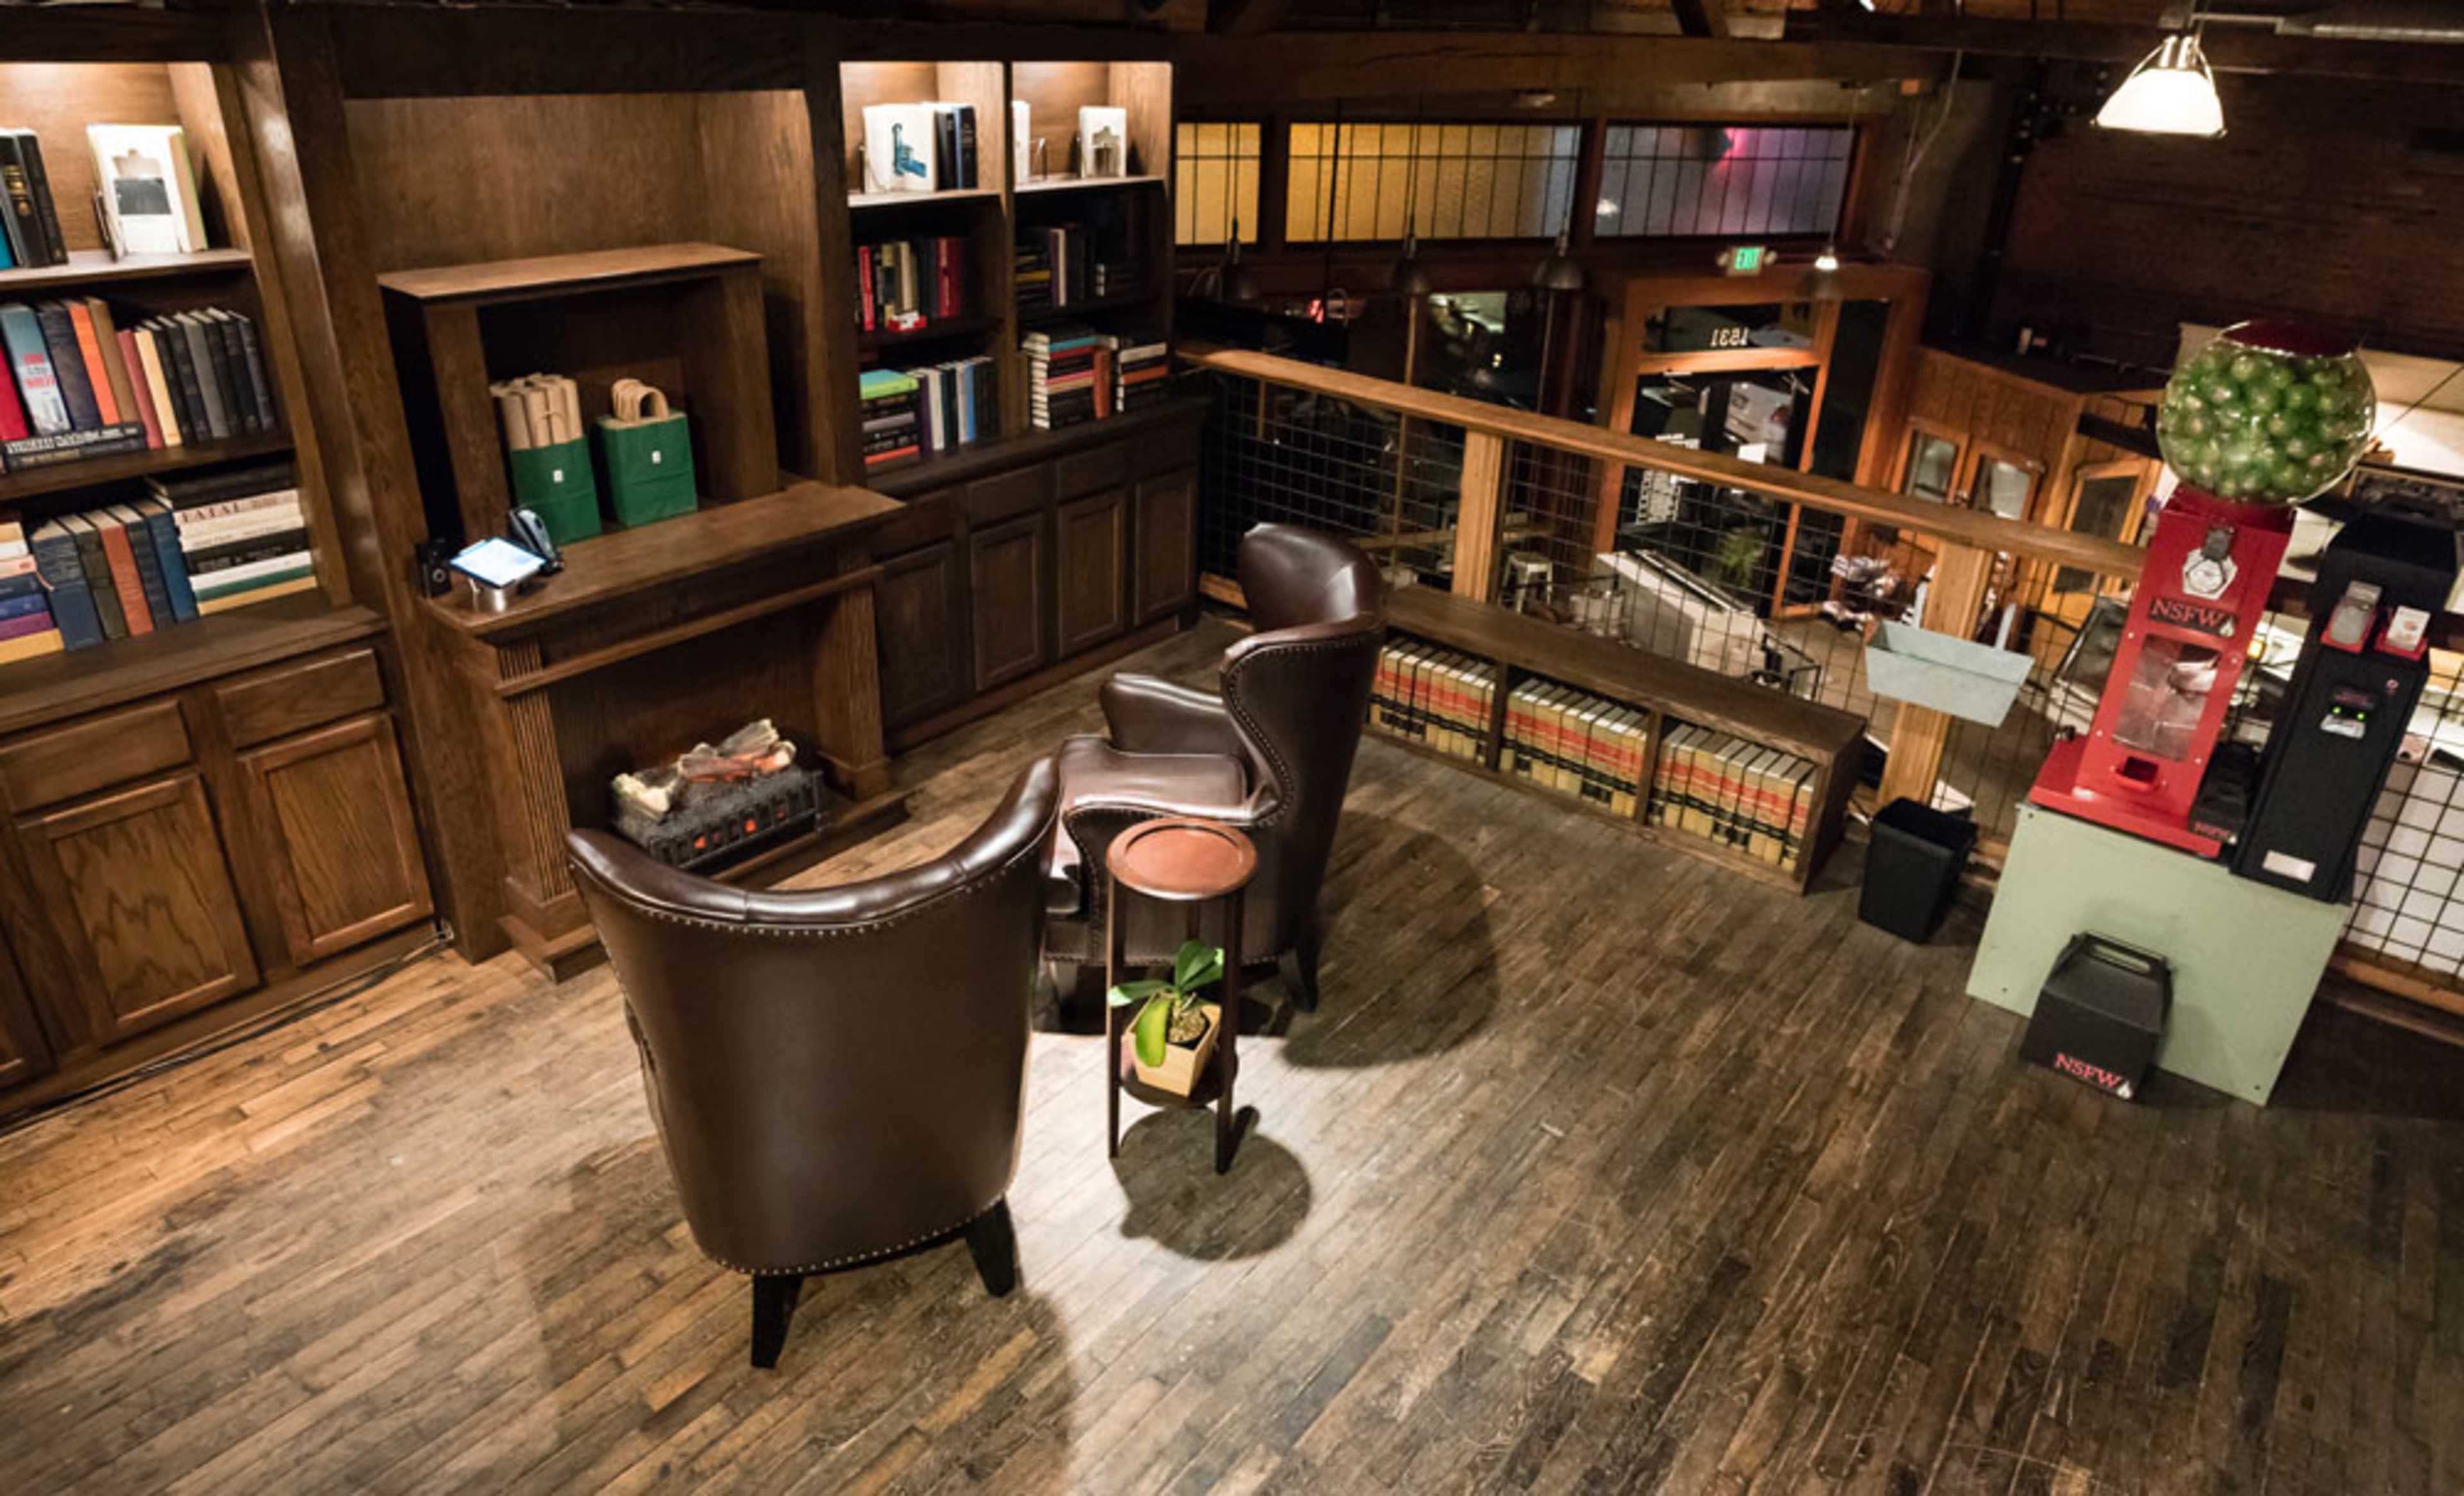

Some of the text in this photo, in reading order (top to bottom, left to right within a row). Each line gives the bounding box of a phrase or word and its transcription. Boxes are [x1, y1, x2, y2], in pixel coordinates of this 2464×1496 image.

[1734, 248, 1761, 270] EXIT
[2152, 596, 2224, 627] NSFW
[2055, 1052, 2123, 1088] NSFW
